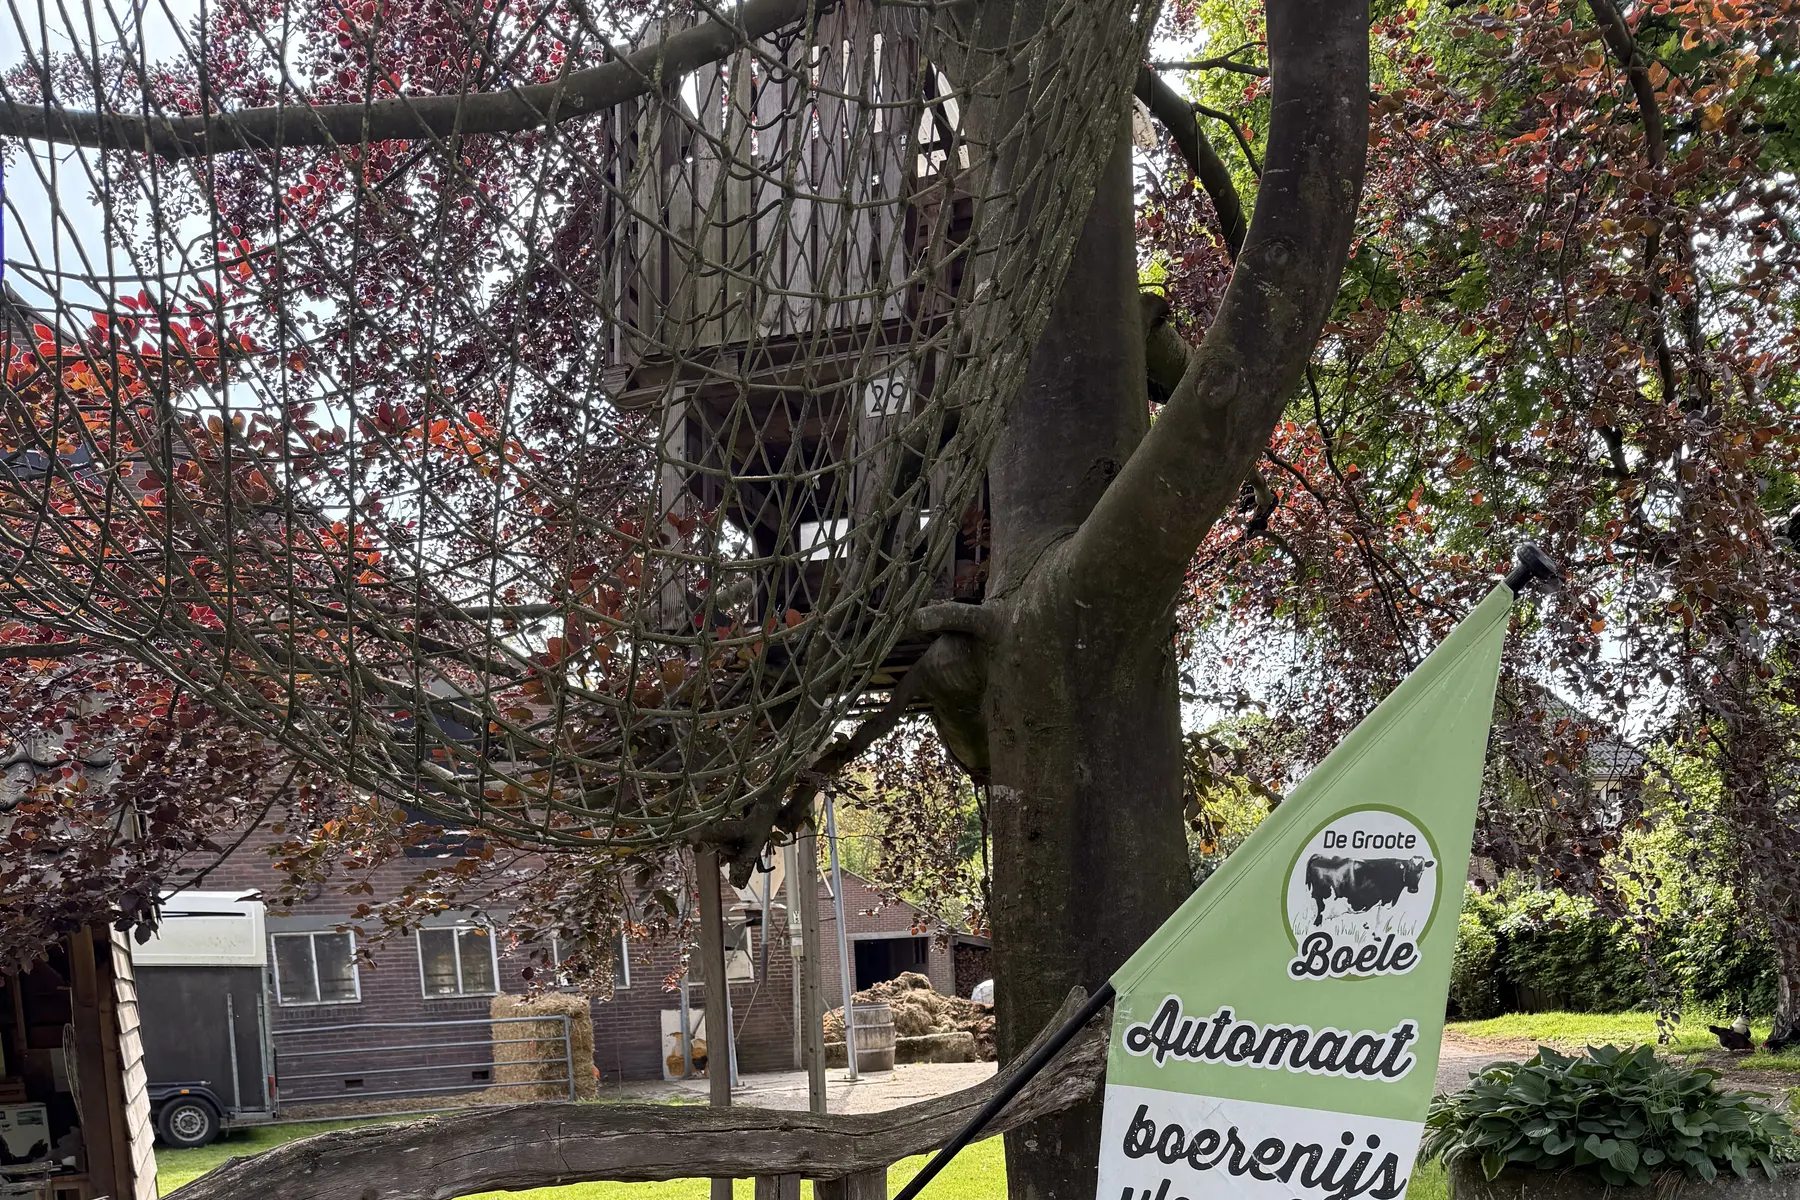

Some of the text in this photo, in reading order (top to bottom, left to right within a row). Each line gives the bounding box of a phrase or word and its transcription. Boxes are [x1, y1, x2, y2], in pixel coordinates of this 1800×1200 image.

[871, 382, 905, 412] 29
[1323, 830, 1416, 849] De Groote
[1291, 931, 1418, 977] Boele
[1126, 999, 1415, 1079] Automaat
